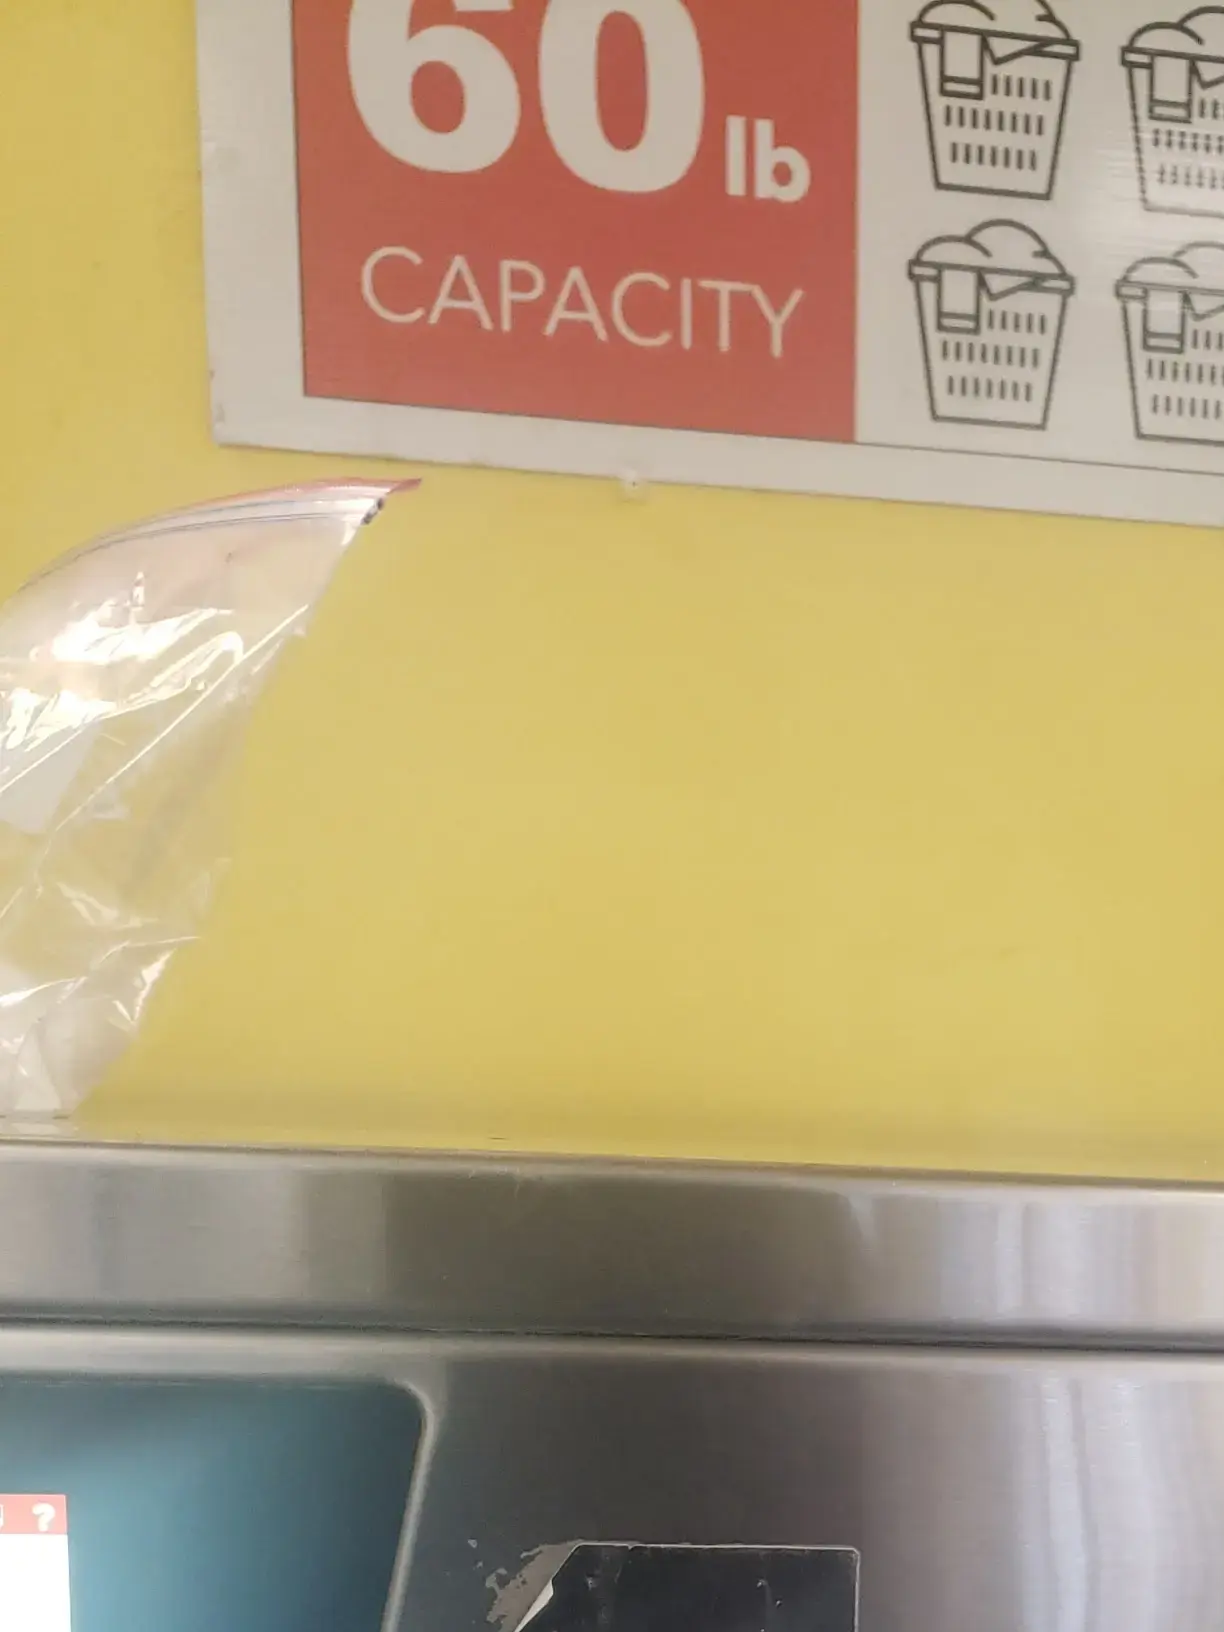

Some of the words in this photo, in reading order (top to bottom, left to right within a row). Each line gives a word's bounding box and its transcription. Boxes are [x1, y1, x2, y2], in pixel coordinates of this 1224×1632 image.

[347, 0, 706, 193] 60
[725, 114, 811, 202] lb
[360, 246, 804, 358] CAPACITY
